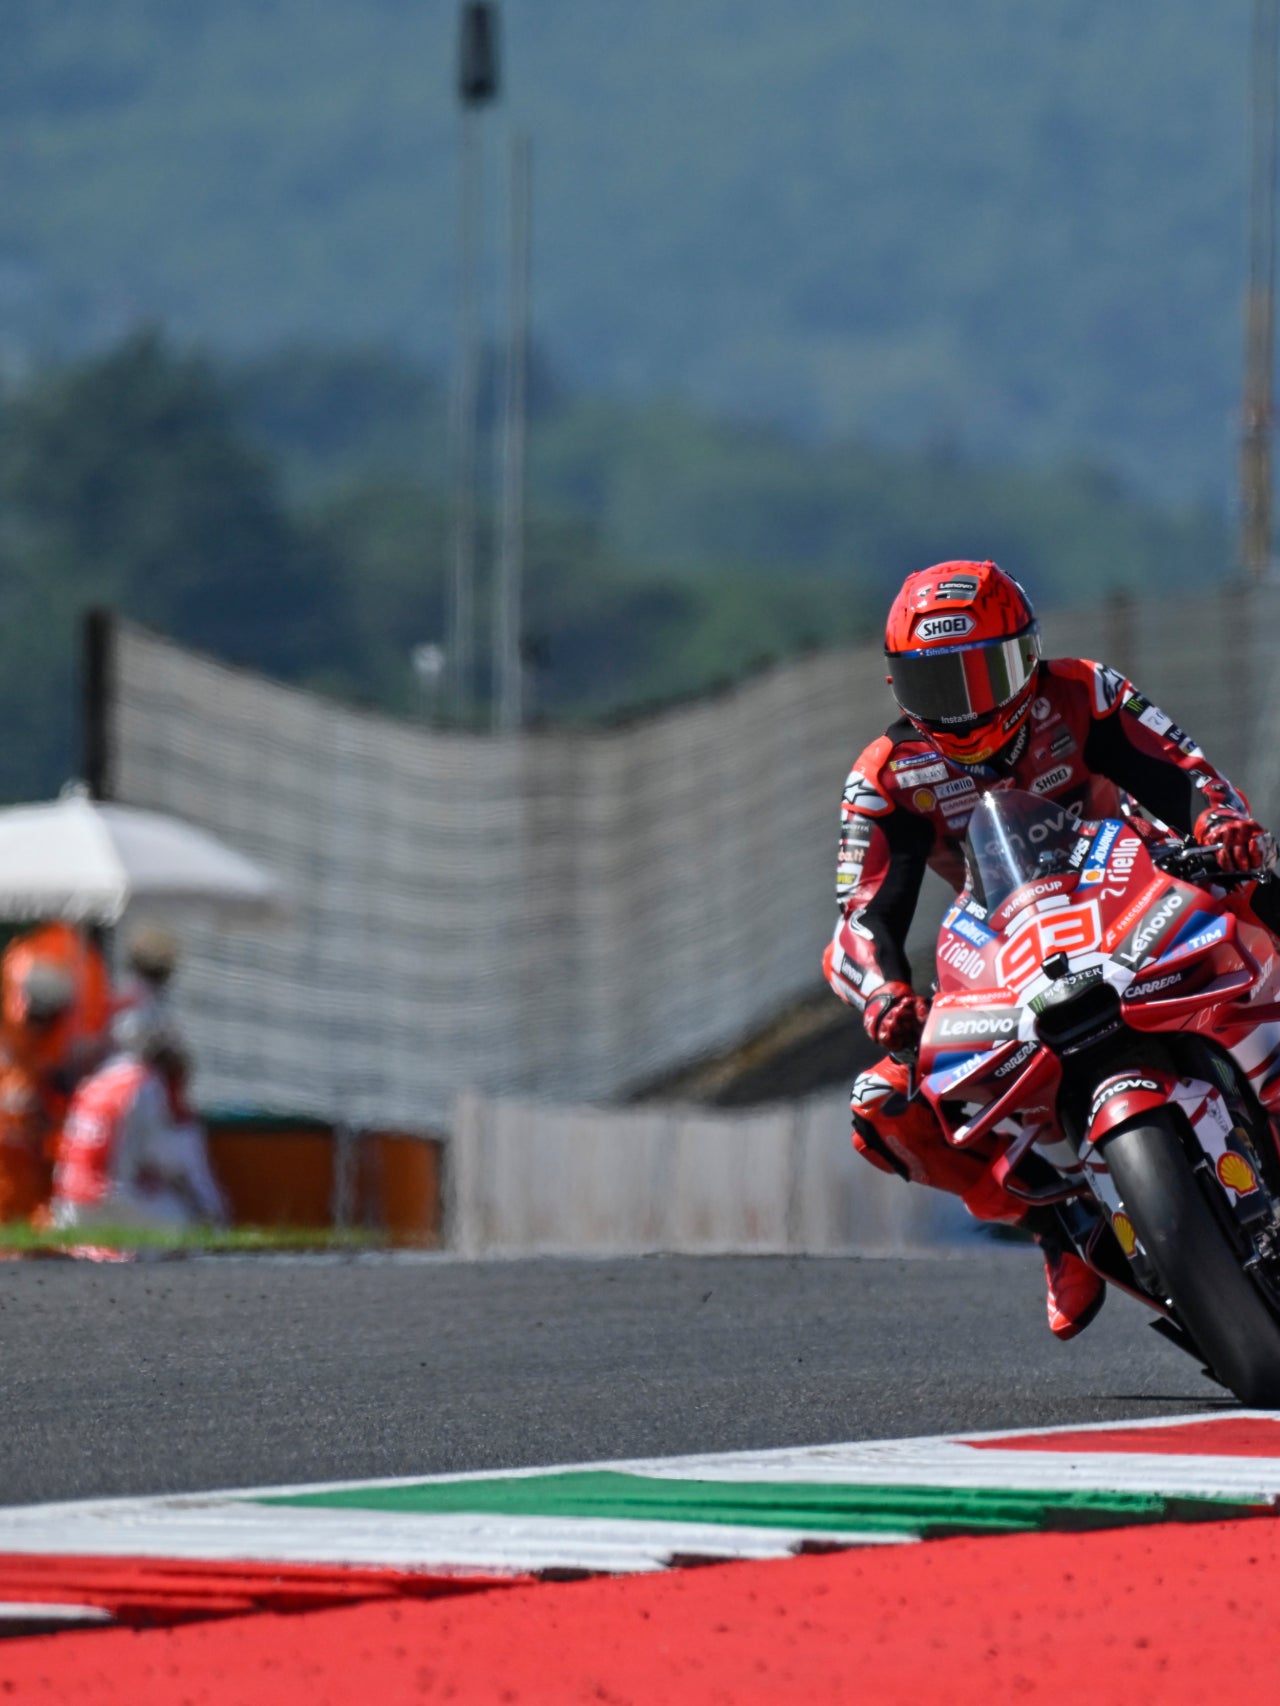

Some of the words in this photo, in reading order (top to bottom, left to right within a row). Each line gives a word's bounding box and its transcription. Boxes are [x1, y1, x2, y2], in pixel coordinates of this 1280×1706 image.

[939, 582, 974, 590] Lenovo
[923, 618, 967, 637] SHOEI
[940, 711, 979, 724] Insta360
[1003, 694, 1033, 731] Lenovo
[1005, 725, 1027, 766] Lenovo
[945, 778, 973, 794] riello
[1034, 768, 1069, 792] SHOEI
[1069, 837, 1091, 868] WRS
[1093, 821, 1121, 865] ADVANCE
[1107, 838, 1142, 882] riello
[1120, 895, 1183, 963] Lenovo
[1189, 929, 1222, 949] TIM
[944, 942, 986, 980] riello
[998, 903, 1099, 993] 93
[842, 959, 863, 986] Lenovo
[1043, 966, 1103, 1000] MONSTER
[1124, 972, 1182, 998] CARRERA
[939, 1017, 1014, 1036] Lenovo
[953, 1053, 983, 1079] TIM
[994, 1041, 1038, 1078] CARRERA
[1088, 1078, 1158, 1127] Lenovo
